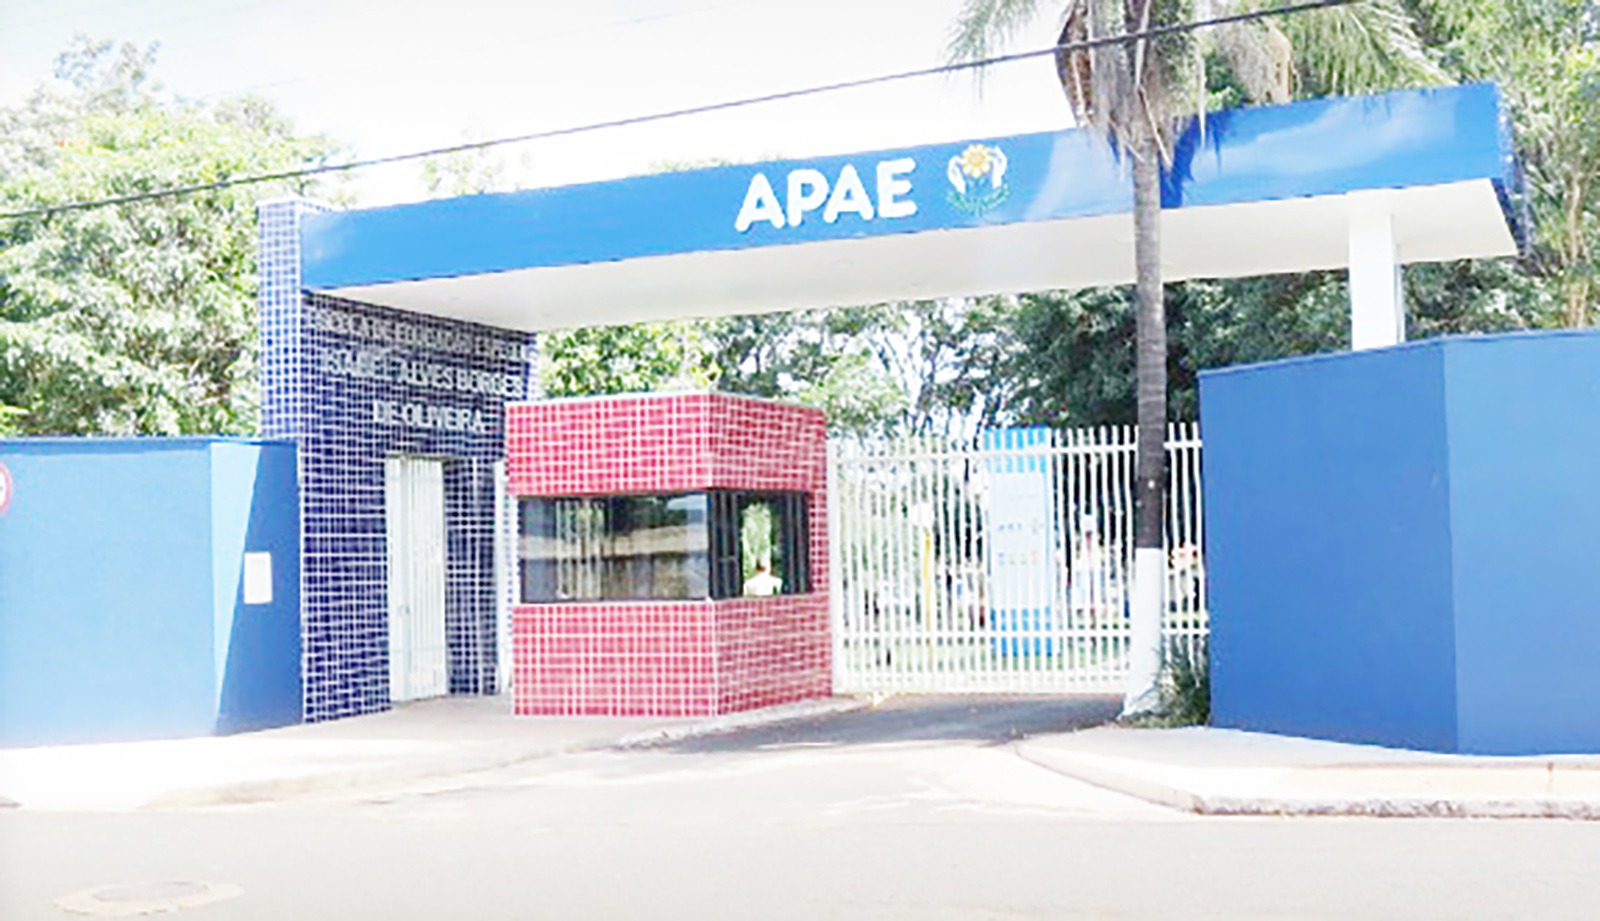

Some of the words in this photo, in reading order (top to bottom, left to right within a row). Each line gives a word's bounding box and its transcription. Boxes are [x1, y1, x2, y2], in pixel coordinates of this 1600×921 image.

[735, 159, 917, 231] APAE
[399, 359, 455, 389] ALVES
[456, 368, 524, 397] BORGES
[373, 401, 401, 424] DE
